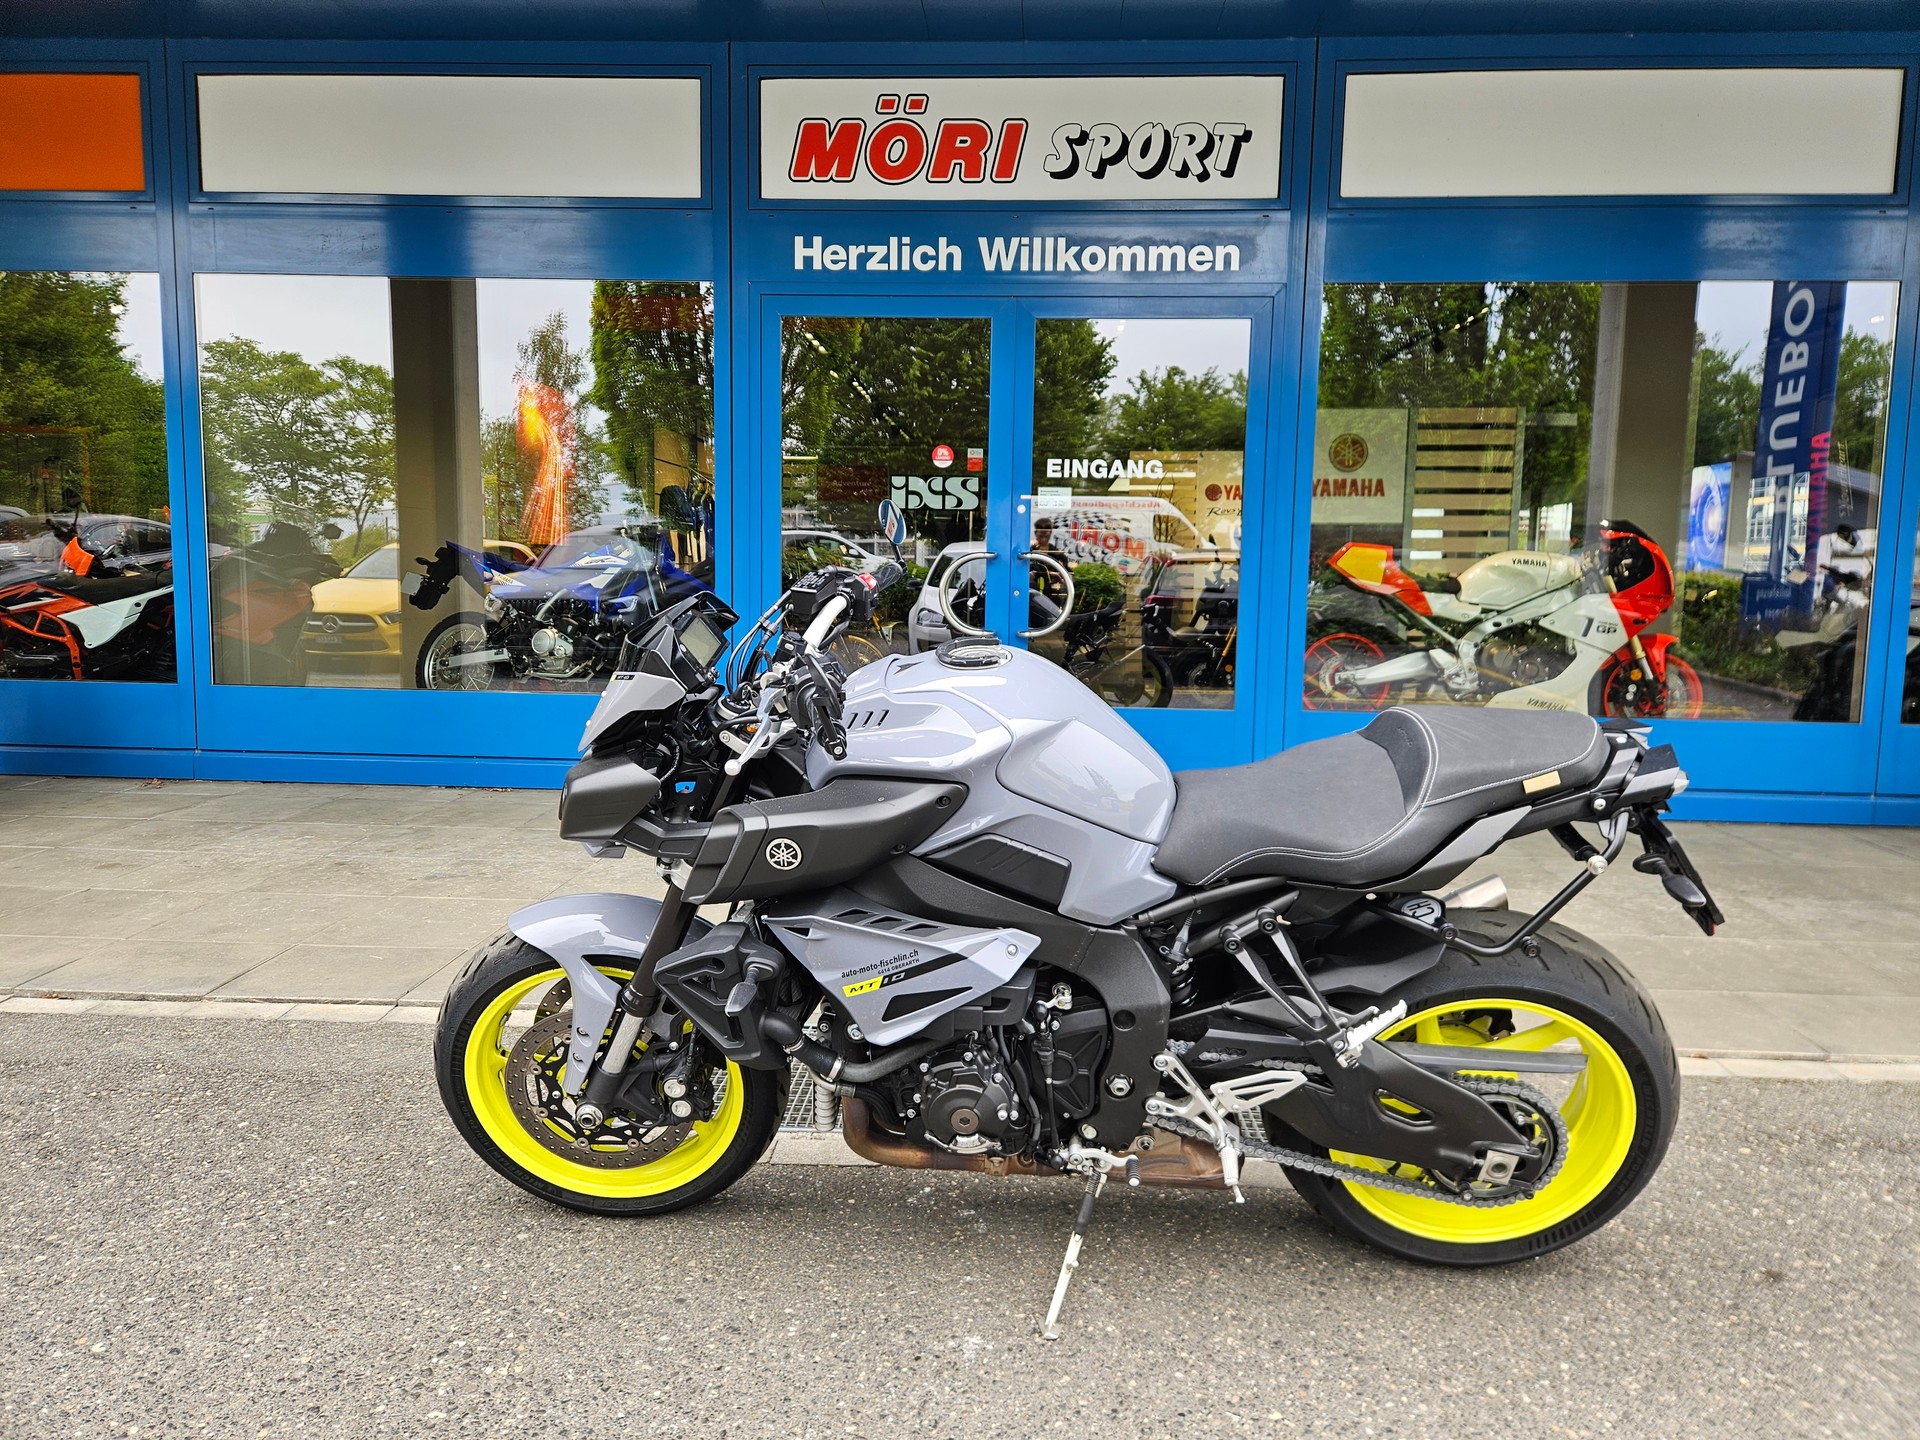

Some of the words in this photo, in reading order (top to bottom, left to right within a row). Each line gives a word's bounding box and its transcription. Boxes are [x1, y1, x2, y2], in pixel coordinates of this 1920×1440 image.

[789, 94, 1028, 184] MÖRI
[1042, 121, 1253, 183] SPORT
[794, 236, 962, 272] Herzlich
[978, 236, 1241, 272] Willkommen
[1046, 458, 1164, 480] EINGANG
[1312, 478, 1385, 497] YAMAHA
[1511, 557, 1548, 568] YAMAHA
[1596, 624, 1617, 634] GP
[841, 949, 919, 978] auto-moto-fischlin.ch
[891, 958, 920, 973] OBERARTH
